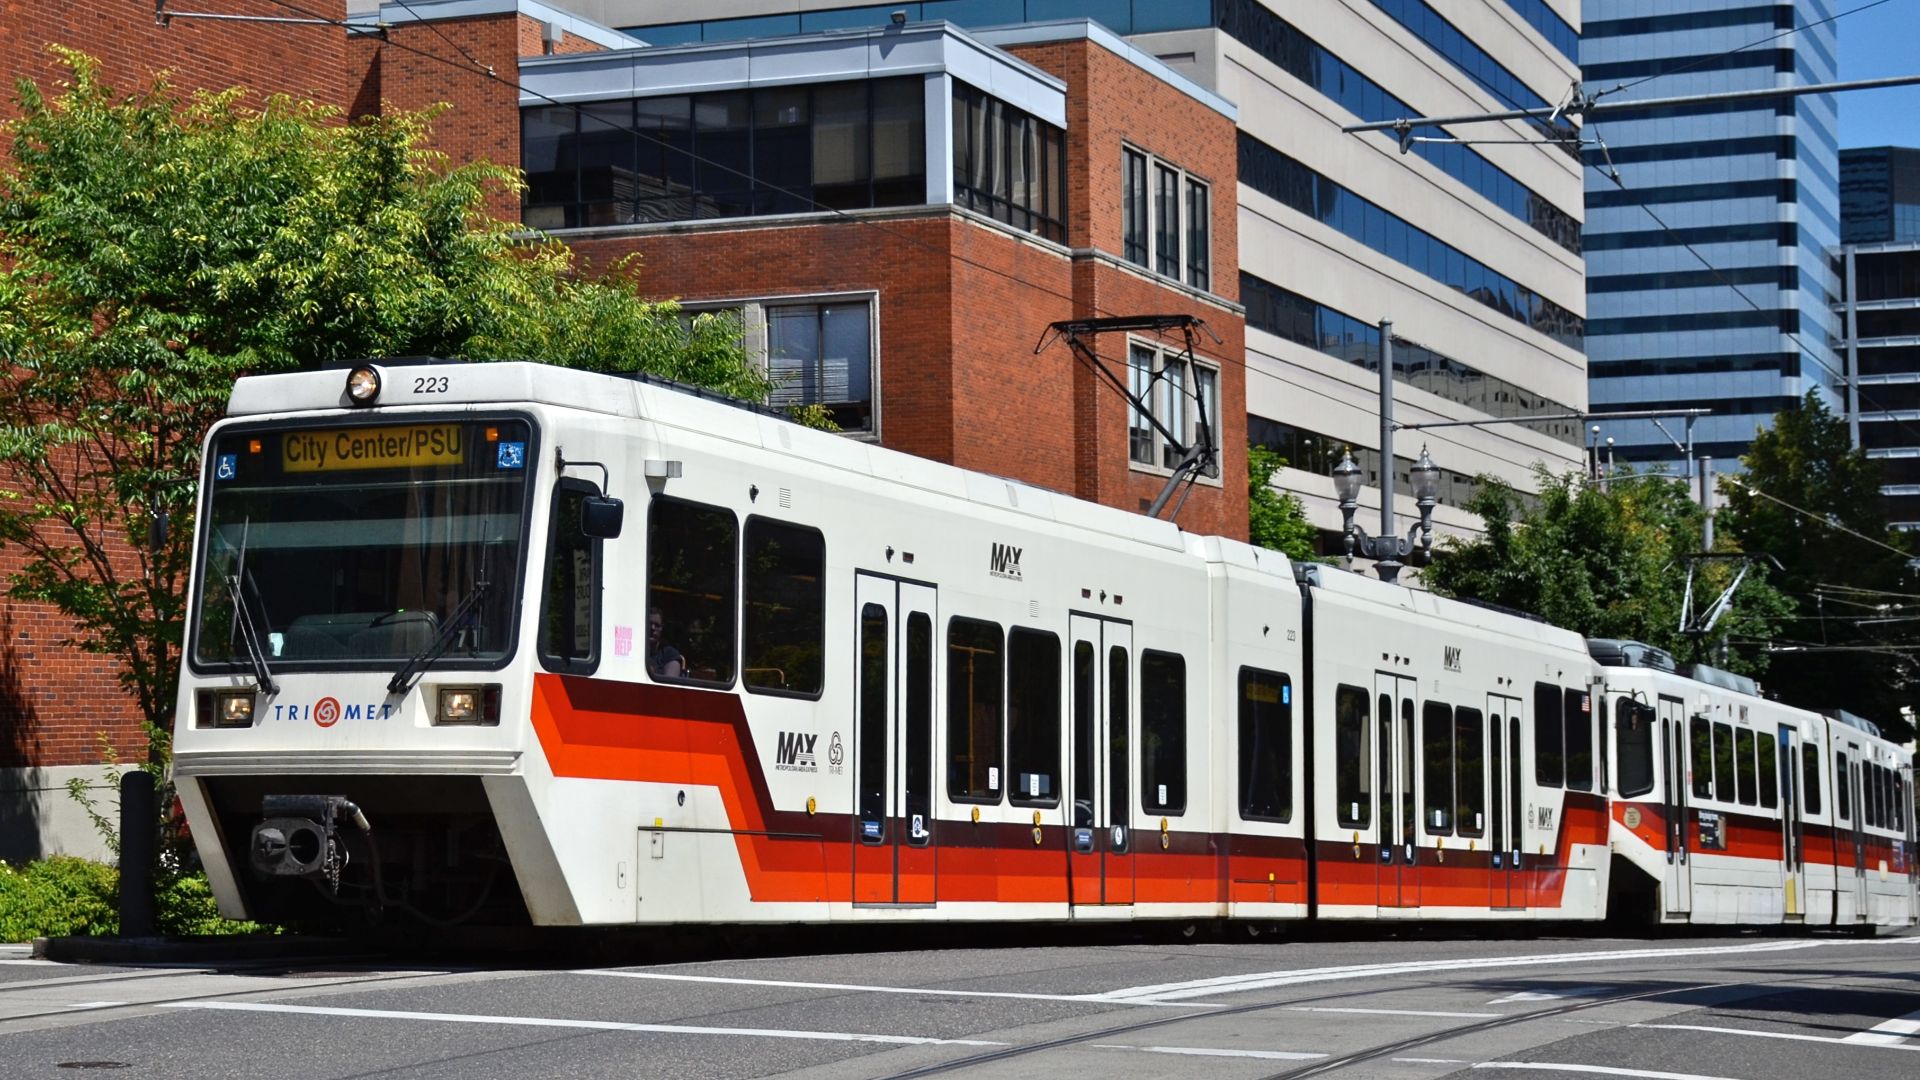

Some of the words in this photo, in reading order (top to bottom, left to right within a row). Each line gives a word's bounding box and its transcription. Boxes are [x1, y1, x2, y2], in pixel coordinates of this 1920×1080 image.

[413, 376, 449, 394] 223
[286, 435, 328, 468] City
[335, 427, 462, 461] Center/PSU
[990, 542, 1023, 576] MAX
[275, 705, 309, 720] TRI
[344, 704, 393, 720] MET
[776, 731, 818, 766] MAX
